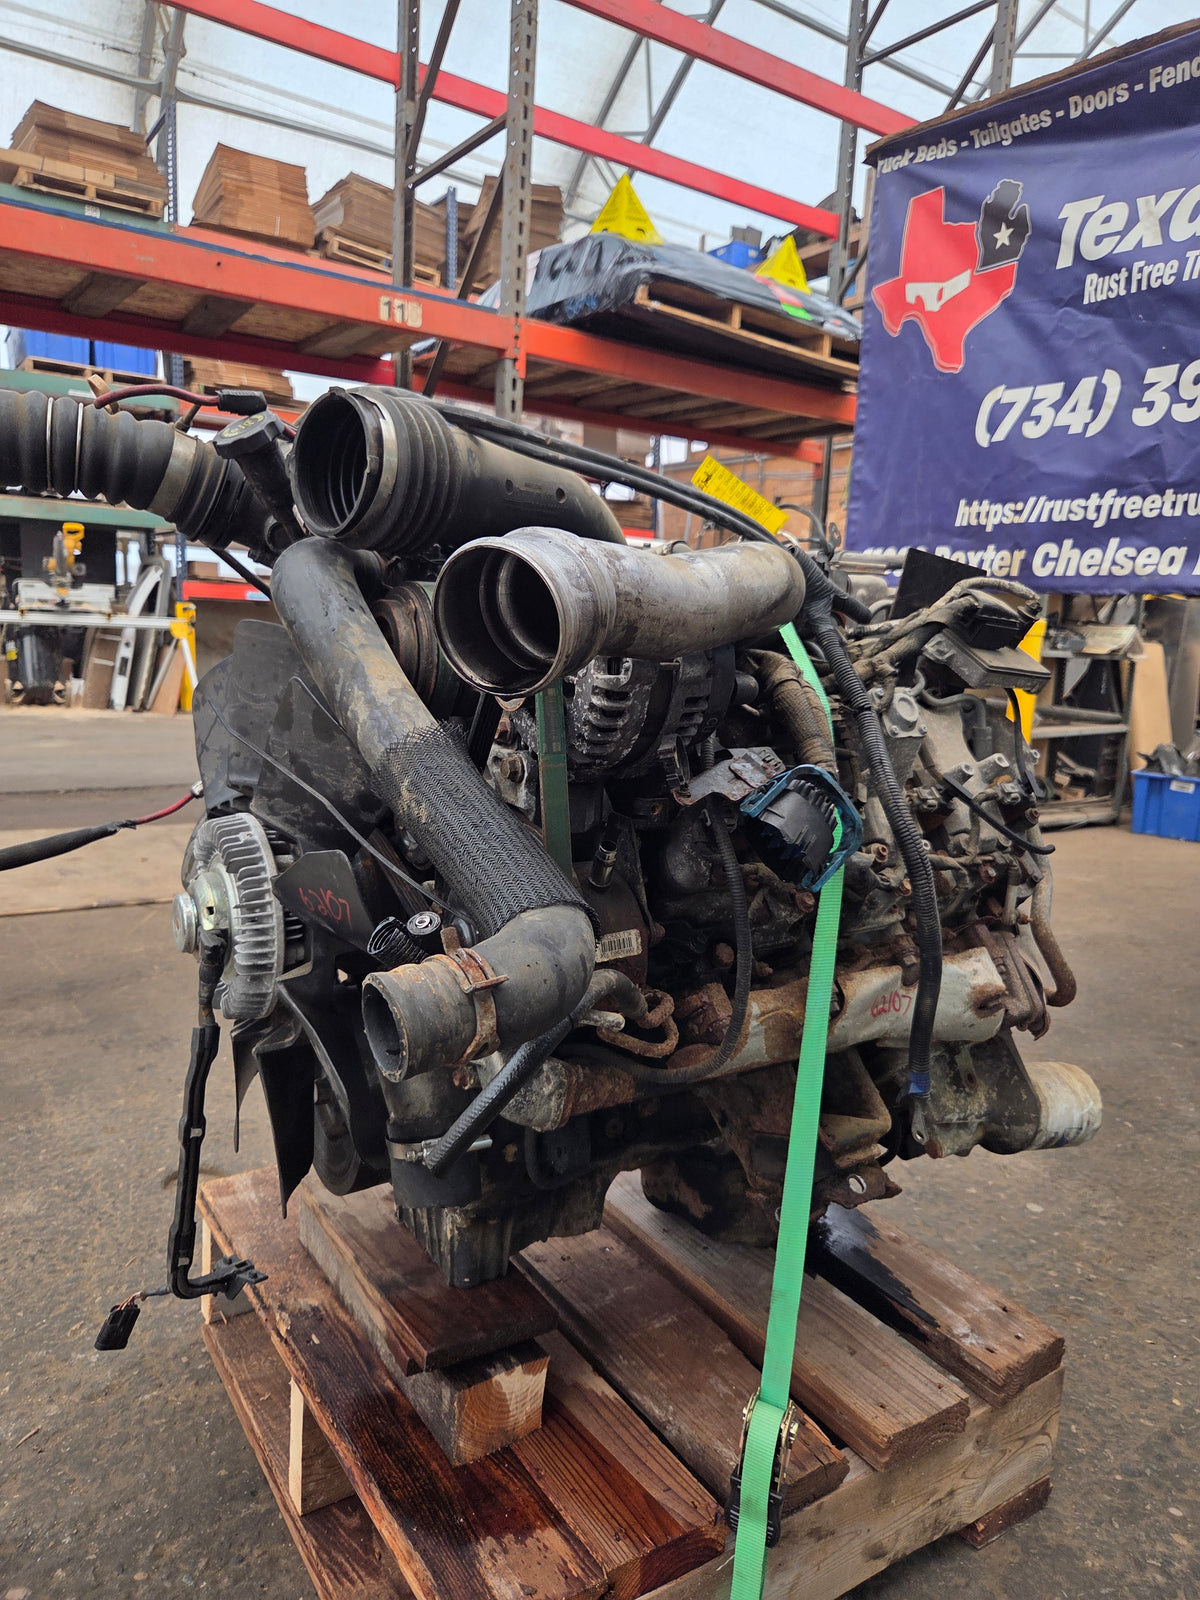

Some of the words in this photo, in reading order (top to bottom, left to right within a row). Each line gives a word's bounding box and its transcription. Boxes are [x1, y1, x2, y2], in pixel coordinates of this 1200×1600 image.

[876, 148, 914, 177] ruck
[913, 138, 958, 164] Beds
[969, 109, 1052, 149] Tailgates
[1069, 83, 1129, 119] Doors
[1083, 267, 1128, 305] Rust
[1130, 260, 1179, 293] Free
[975, 368, 1122, 448] (734)
[1132, 359, 1200, 427] 39
[1031, 537, 1188, 577] Chelsea
